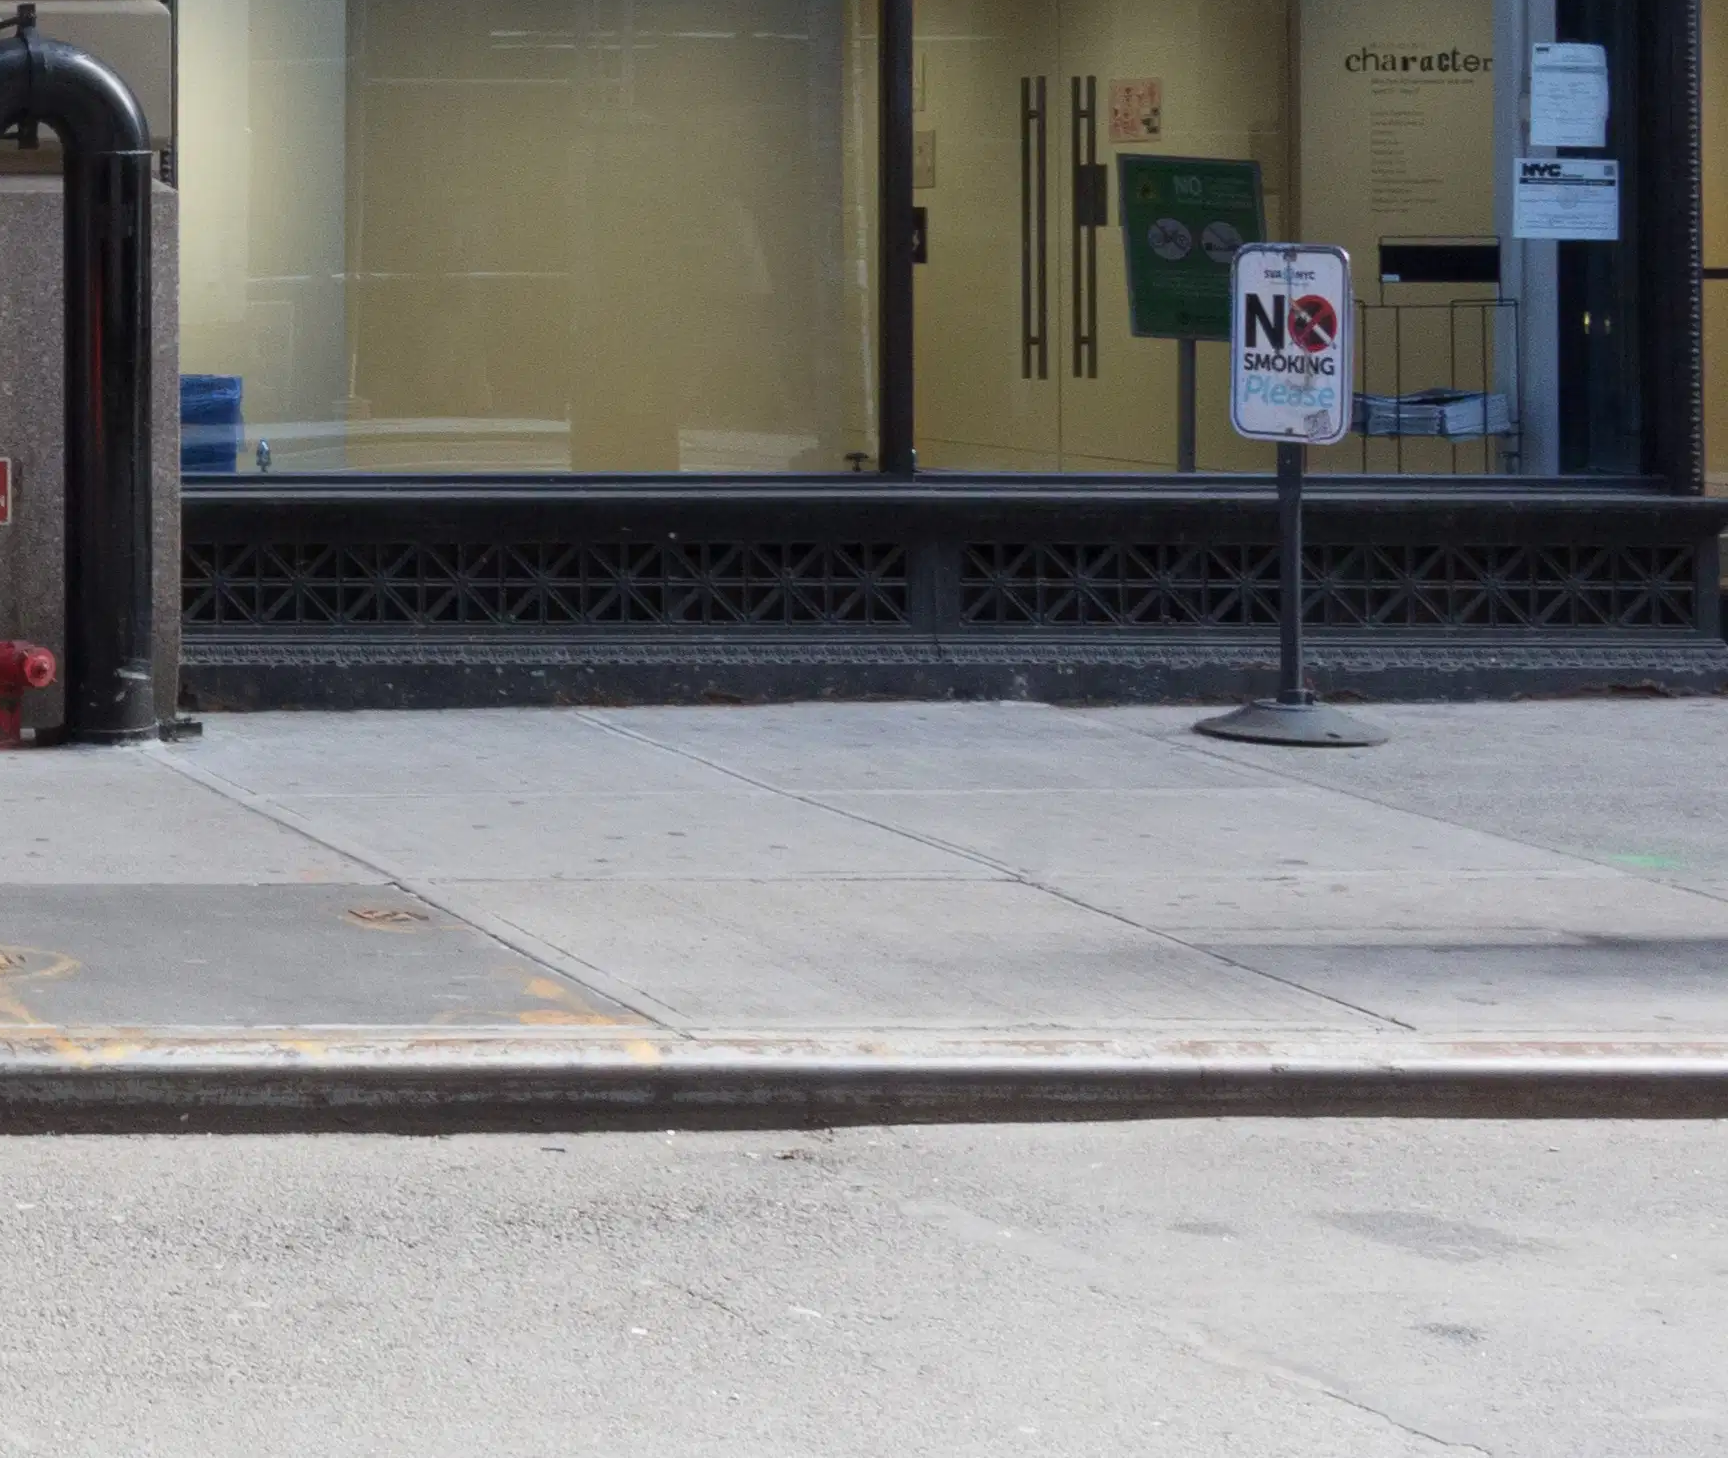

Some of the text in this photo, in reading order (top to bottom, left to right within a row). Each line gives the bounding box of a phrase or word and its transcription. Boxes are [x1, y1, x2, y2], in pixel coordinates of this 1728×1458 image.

[1345, 47, 1493, 73] character
[1522, 163, 1562, 177] NYC
[1244, 353, 1335, 376] SMOKING
[1243, 373, 1335, 410] Please
